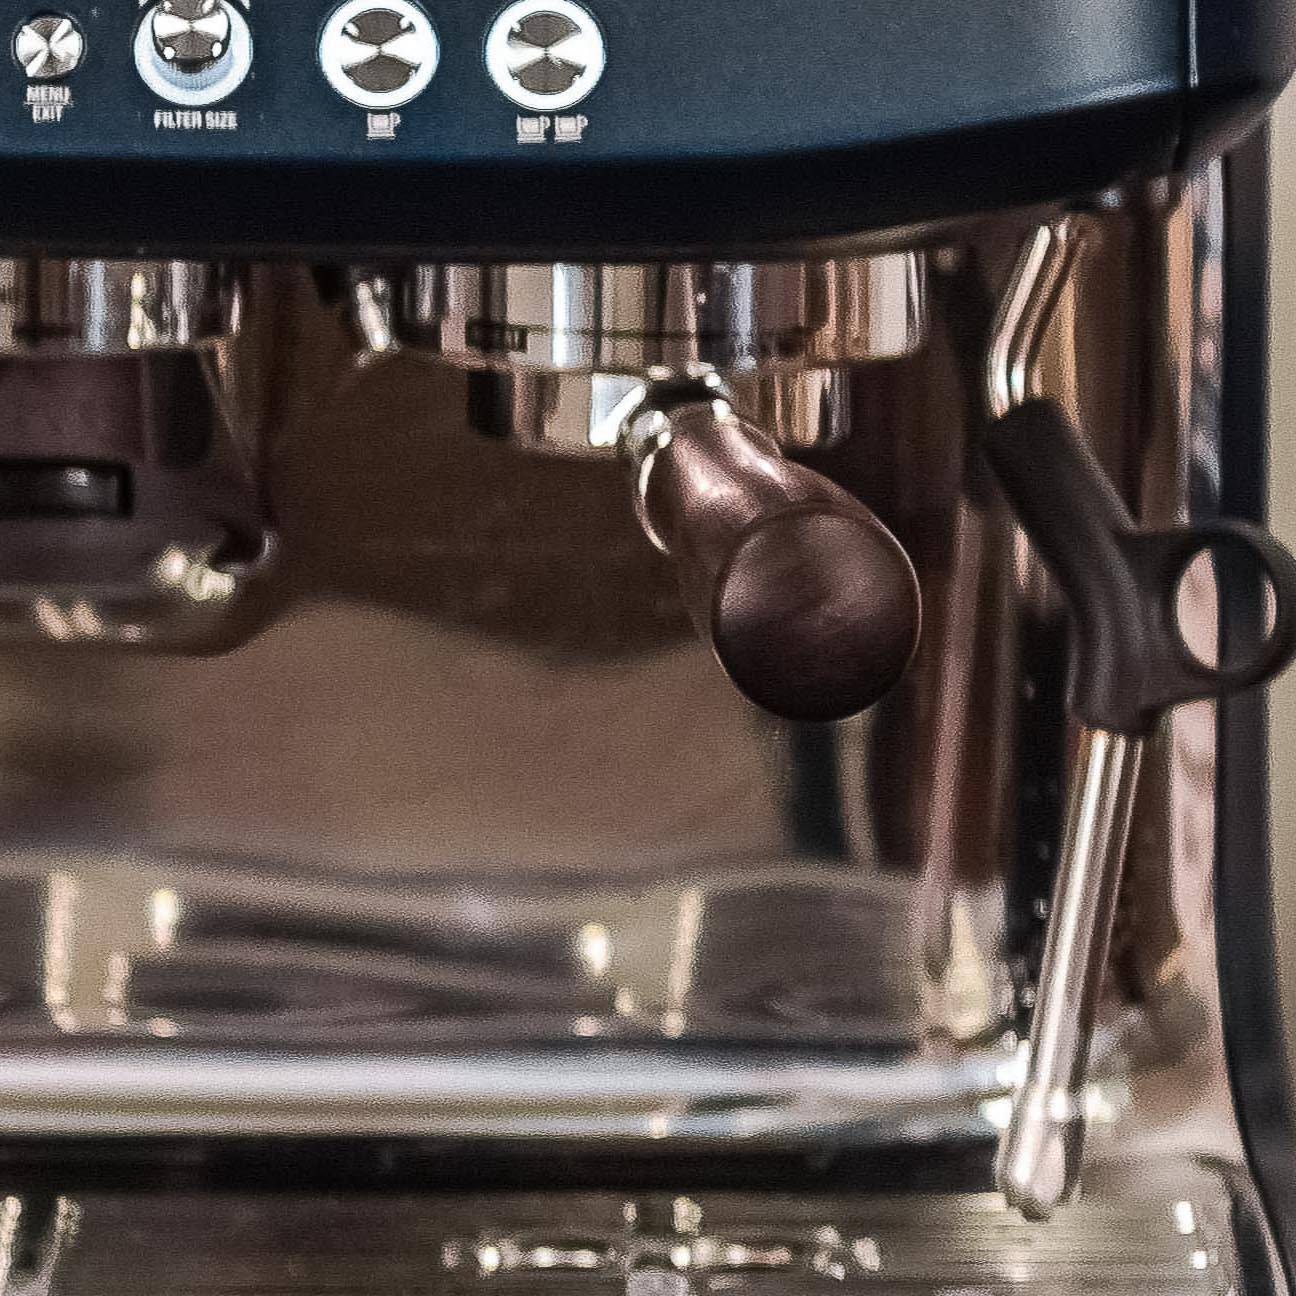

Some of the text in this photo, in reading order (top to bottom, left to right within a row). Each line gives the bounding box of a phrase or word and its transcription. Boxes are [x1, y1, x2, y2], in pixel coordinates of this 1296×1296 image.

[25, 85, 73, 105] MENU
[32, 105, 65, 124] EXIT
[153, 109, 239, 131] FILTER SIZE
